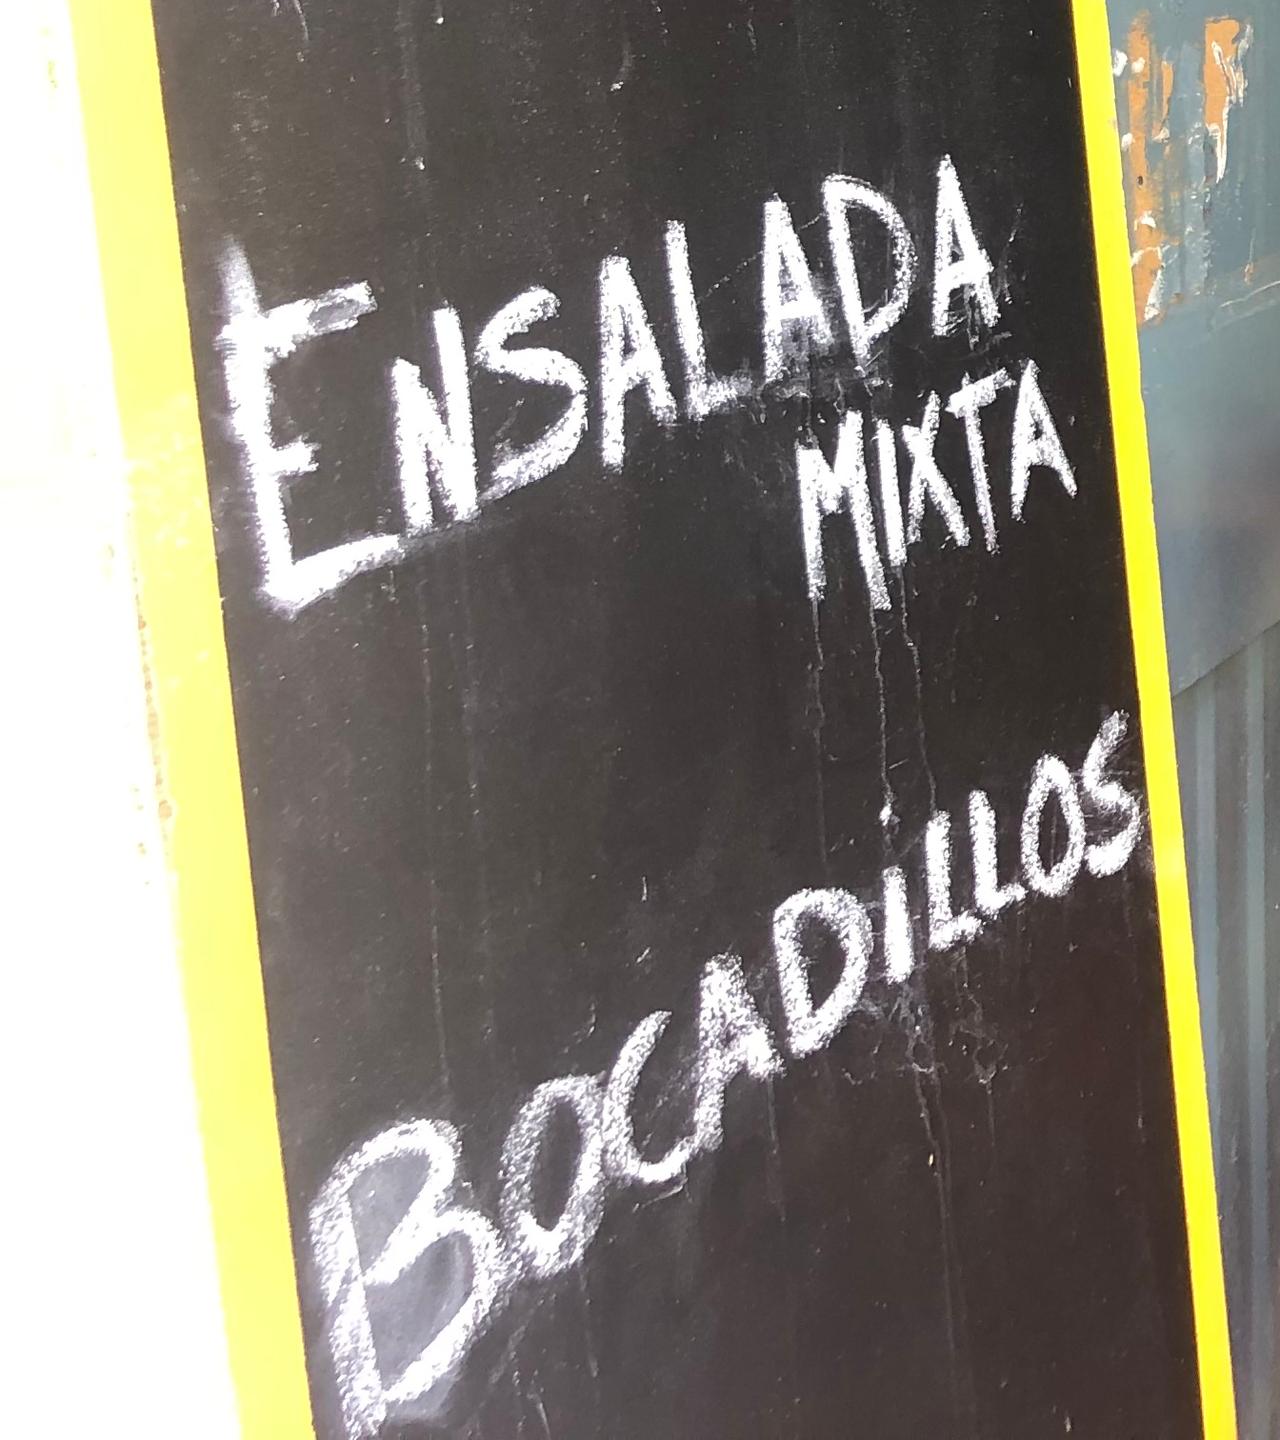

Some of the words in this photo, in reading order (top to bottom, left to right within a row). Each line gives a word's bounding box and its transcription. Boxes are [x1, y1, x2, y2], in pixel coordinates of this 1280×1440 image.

[213, 154, 1000, 620] ENSALADA
[799, 359, 1078, 611] MIXTA
[310, 708, 1145, 1440] BOCADILLOS
